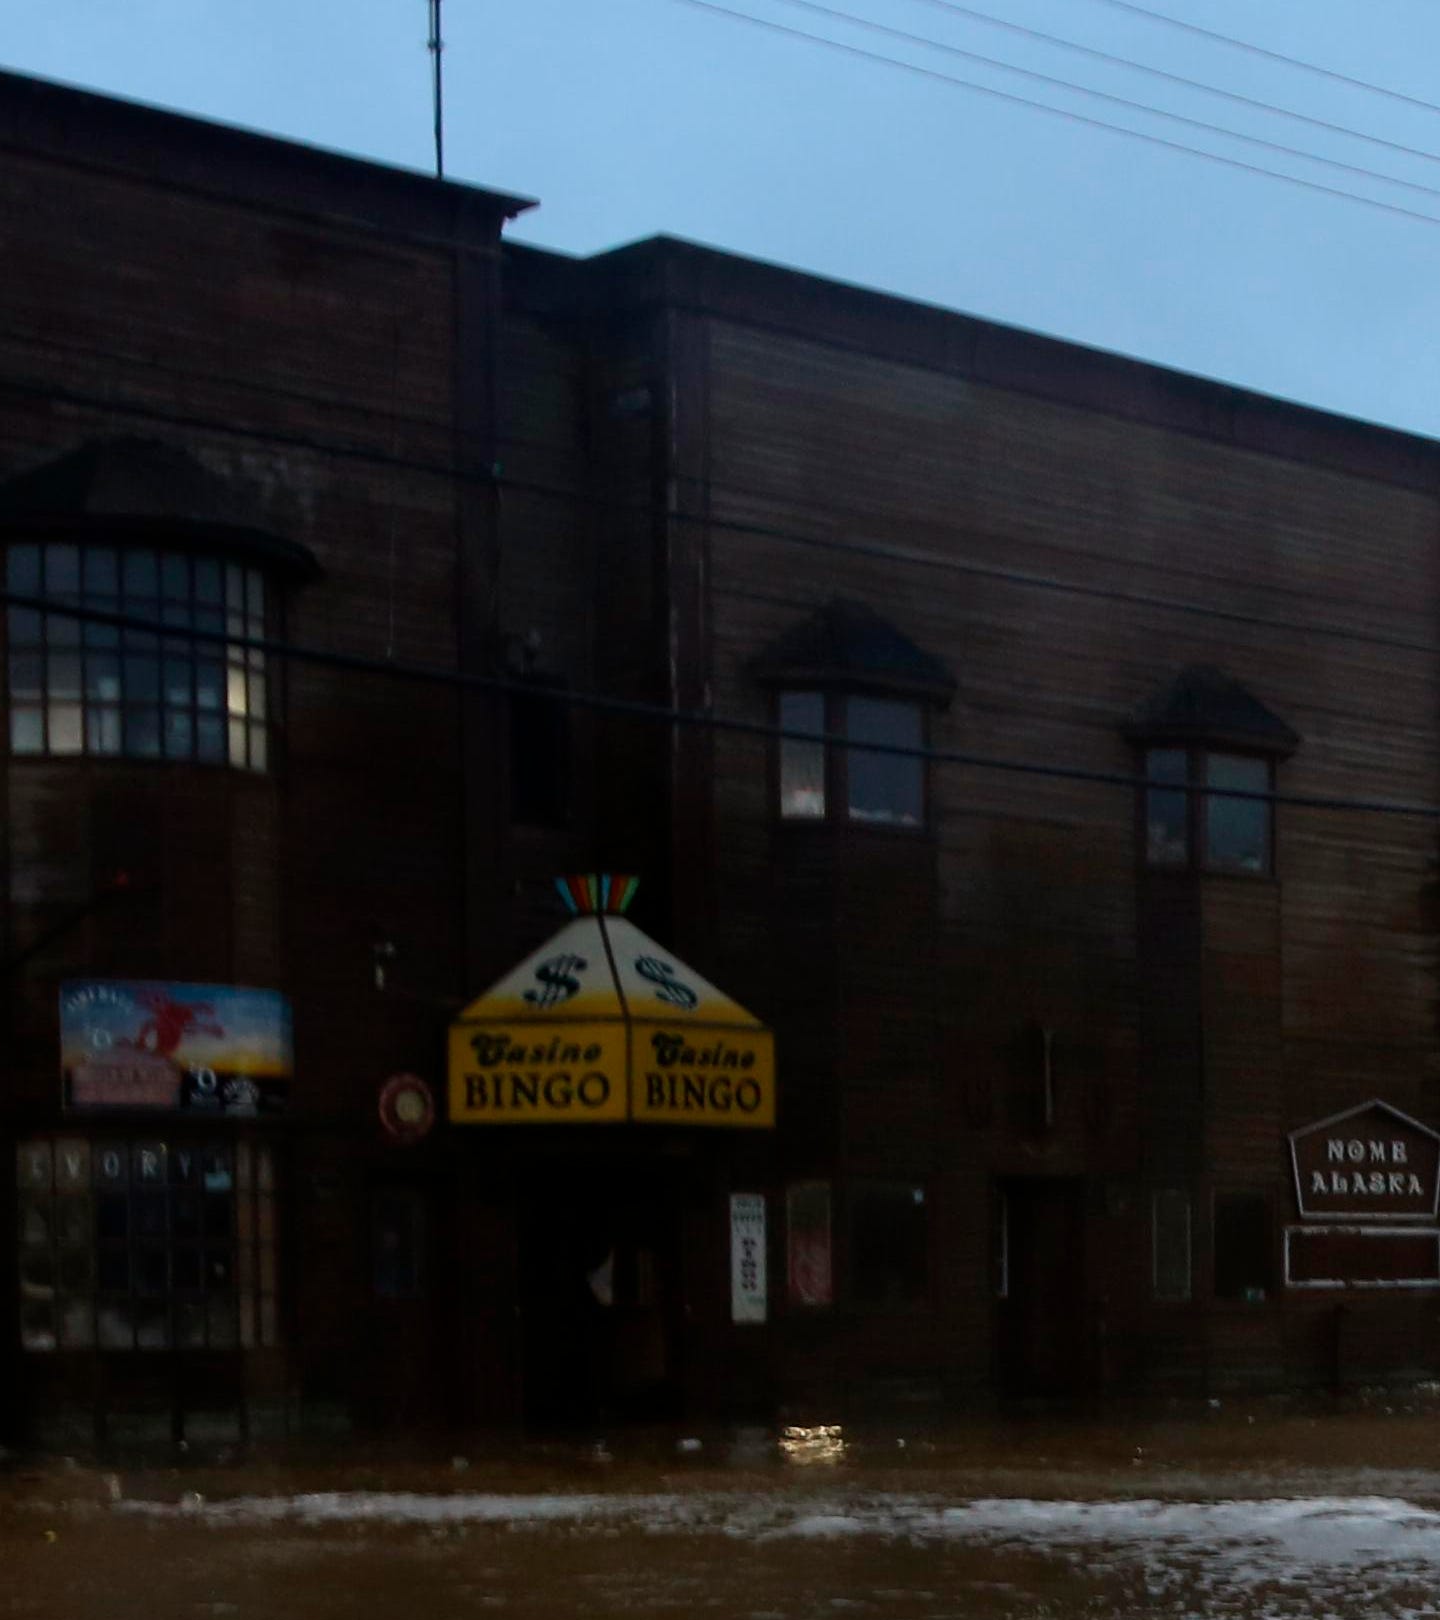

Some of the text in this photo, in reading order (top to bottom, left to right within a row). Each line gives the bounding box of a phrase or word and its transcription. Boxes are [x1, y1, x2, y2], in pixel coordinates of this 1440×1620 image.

[470, 1033, 602, 1068] Casino
[652, 1031, 756, 1068] Casino
[464, 1070, 611, 1110] BINGO
[645, 1071, 761, 1112] BINGO
[1327, 1139, 1409, 1163] NOME
[1311, 1170, 1425, 1196] ALASKA
